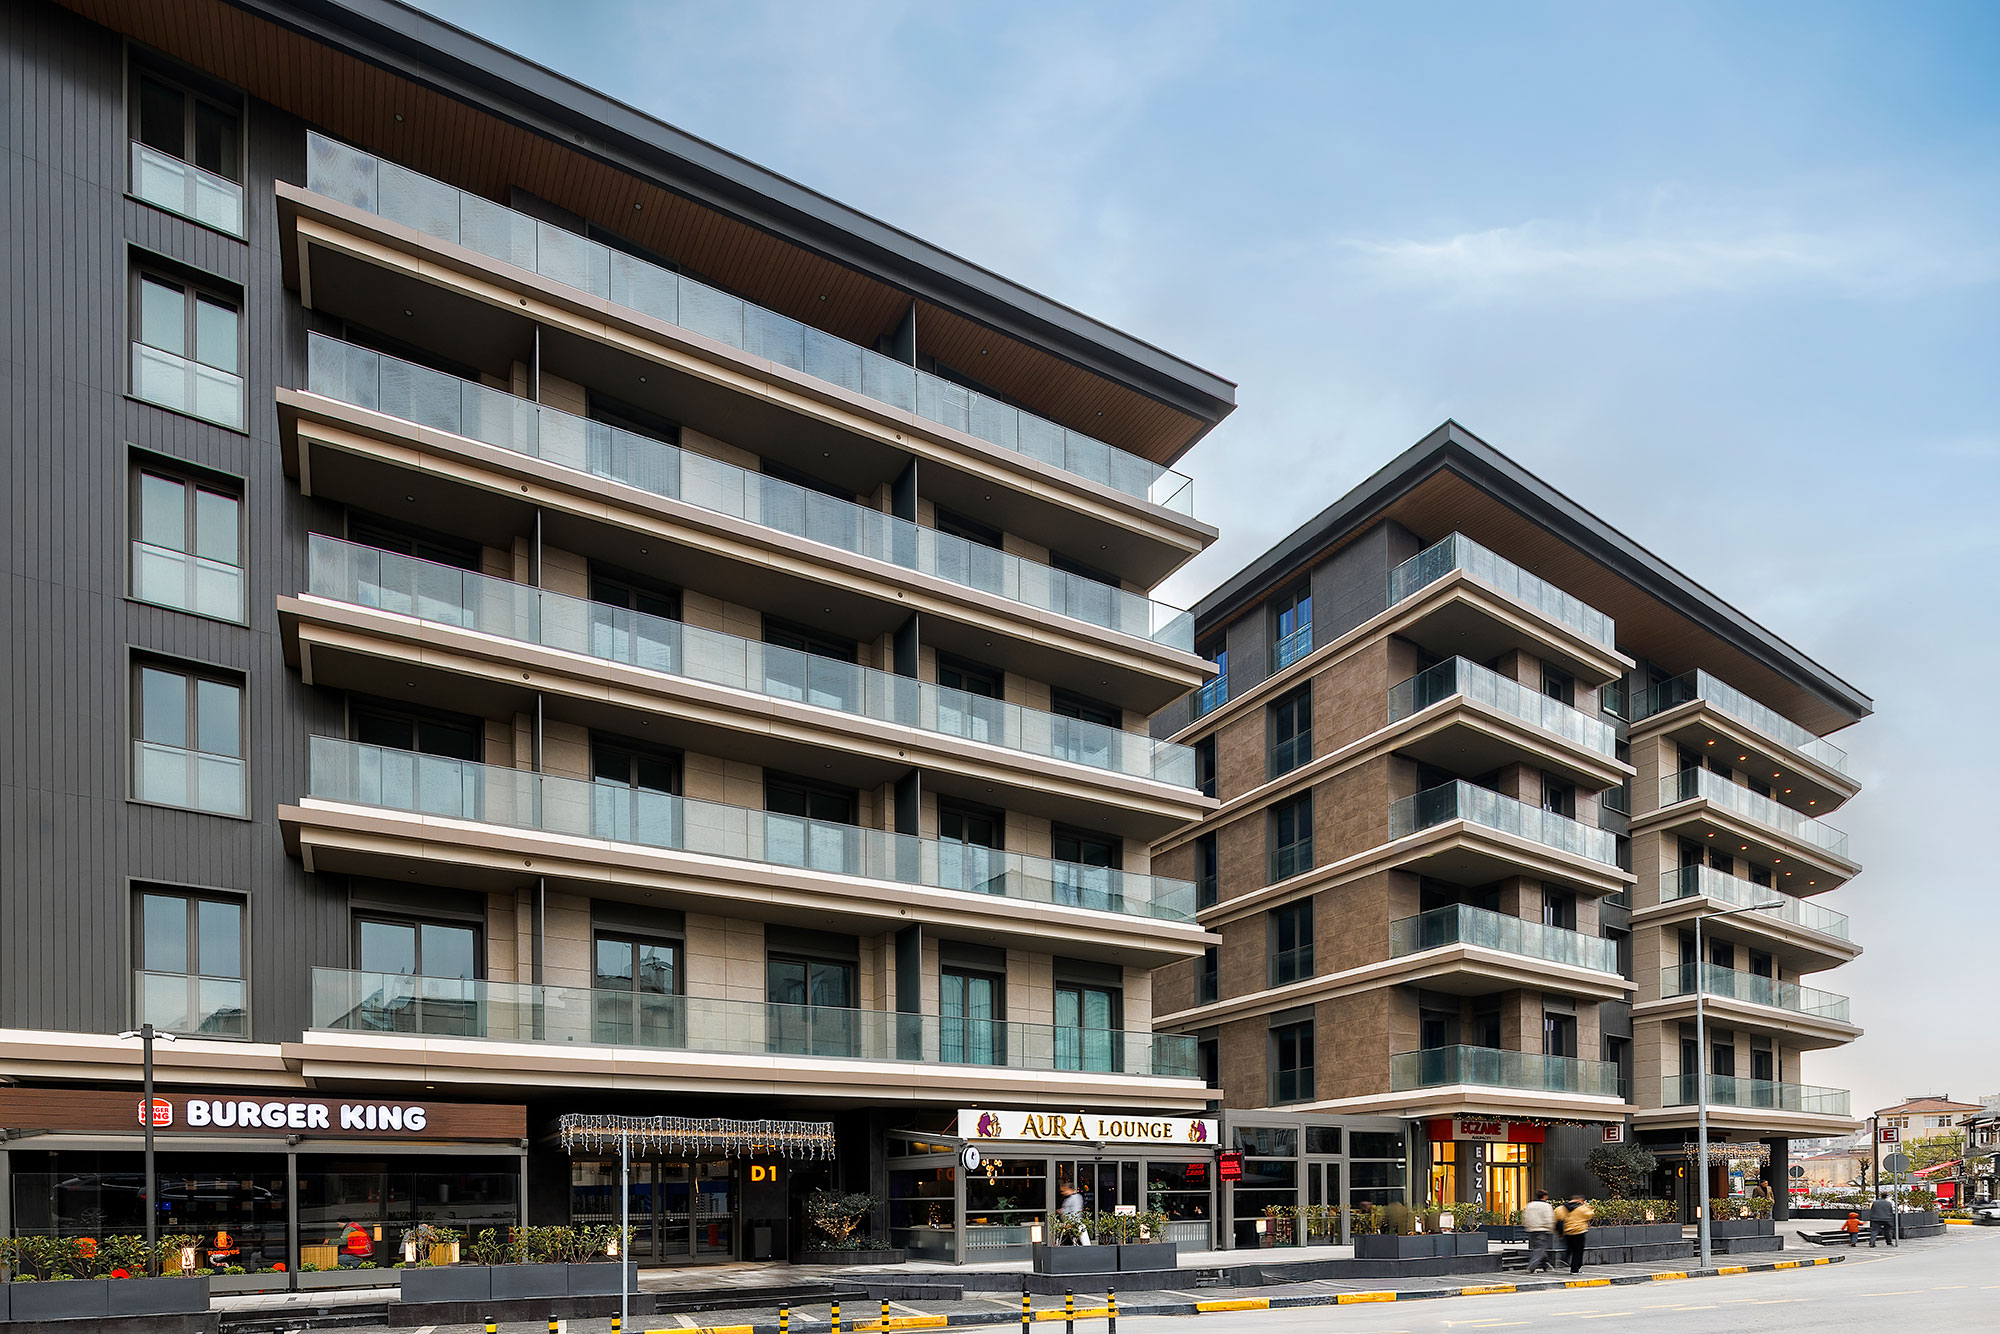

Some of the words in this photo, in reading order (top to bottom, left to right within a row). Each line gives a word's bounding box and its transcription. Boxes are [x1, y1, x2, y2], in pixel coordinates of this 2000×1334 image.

[187, 1099, 330, 1129] BURGER
[340, 1104, 427, 1131] KING
[1020, 1113, 1090, 1139] AURA
[1098, 1120, 1173, 1138] LOUNGE
[1461, 1121, 1501, 1135] ECZANE
[751, 1165, 776, 1181] D1
